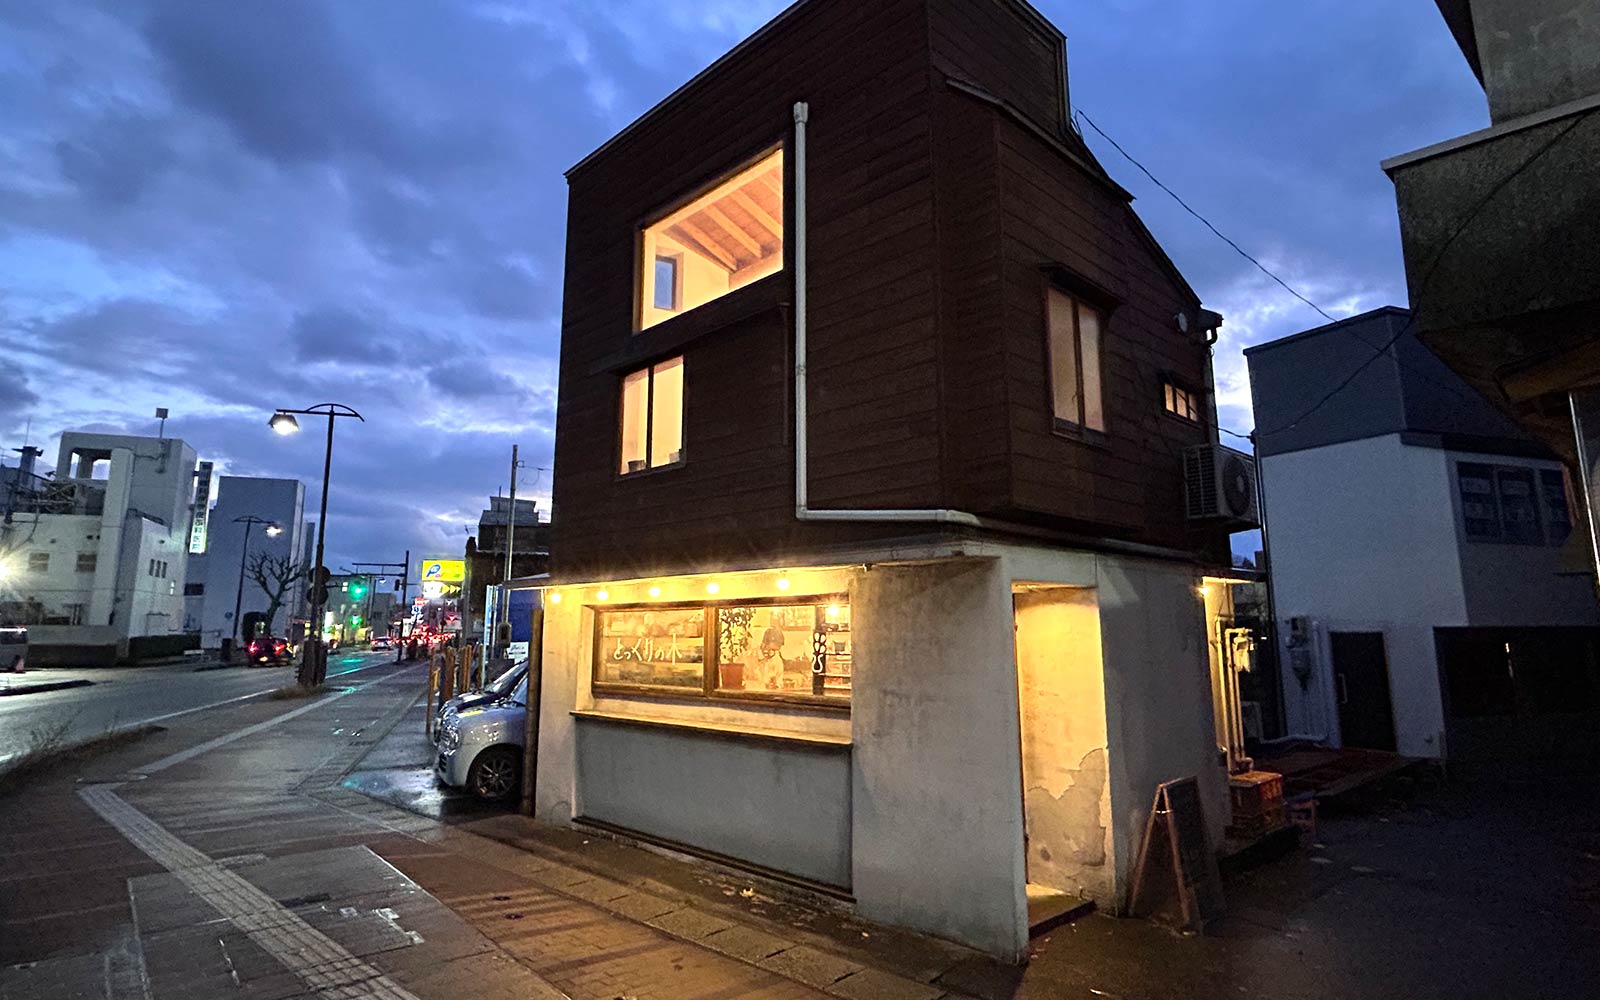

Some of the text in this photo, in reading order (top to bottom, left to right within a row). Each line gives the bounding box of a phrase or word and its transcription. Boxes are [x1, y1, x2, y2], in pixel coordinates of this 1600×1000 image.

[613, 632, 683, 666] とっくりの木
